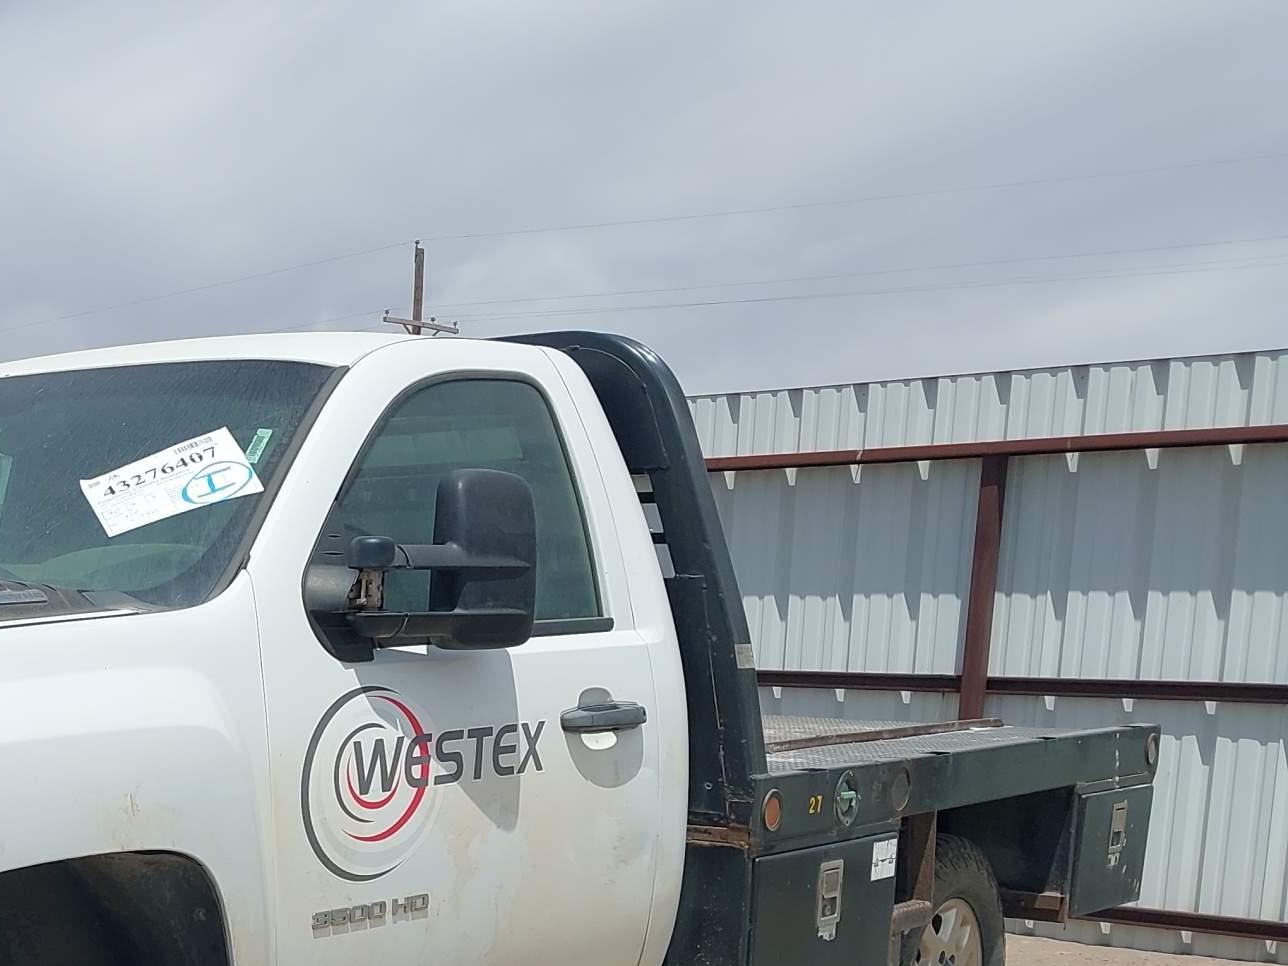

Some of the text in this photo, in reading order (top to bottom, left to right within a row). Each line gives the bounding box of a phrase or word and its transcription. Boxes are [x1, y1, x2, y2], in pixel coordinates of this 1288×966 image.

[103, 445, 217, 498] 43276407
[352, 719, 547, 797] WESTEX
[808, 794, 824, 816] 27
[311, 893, 430, 932] 3500 HD
